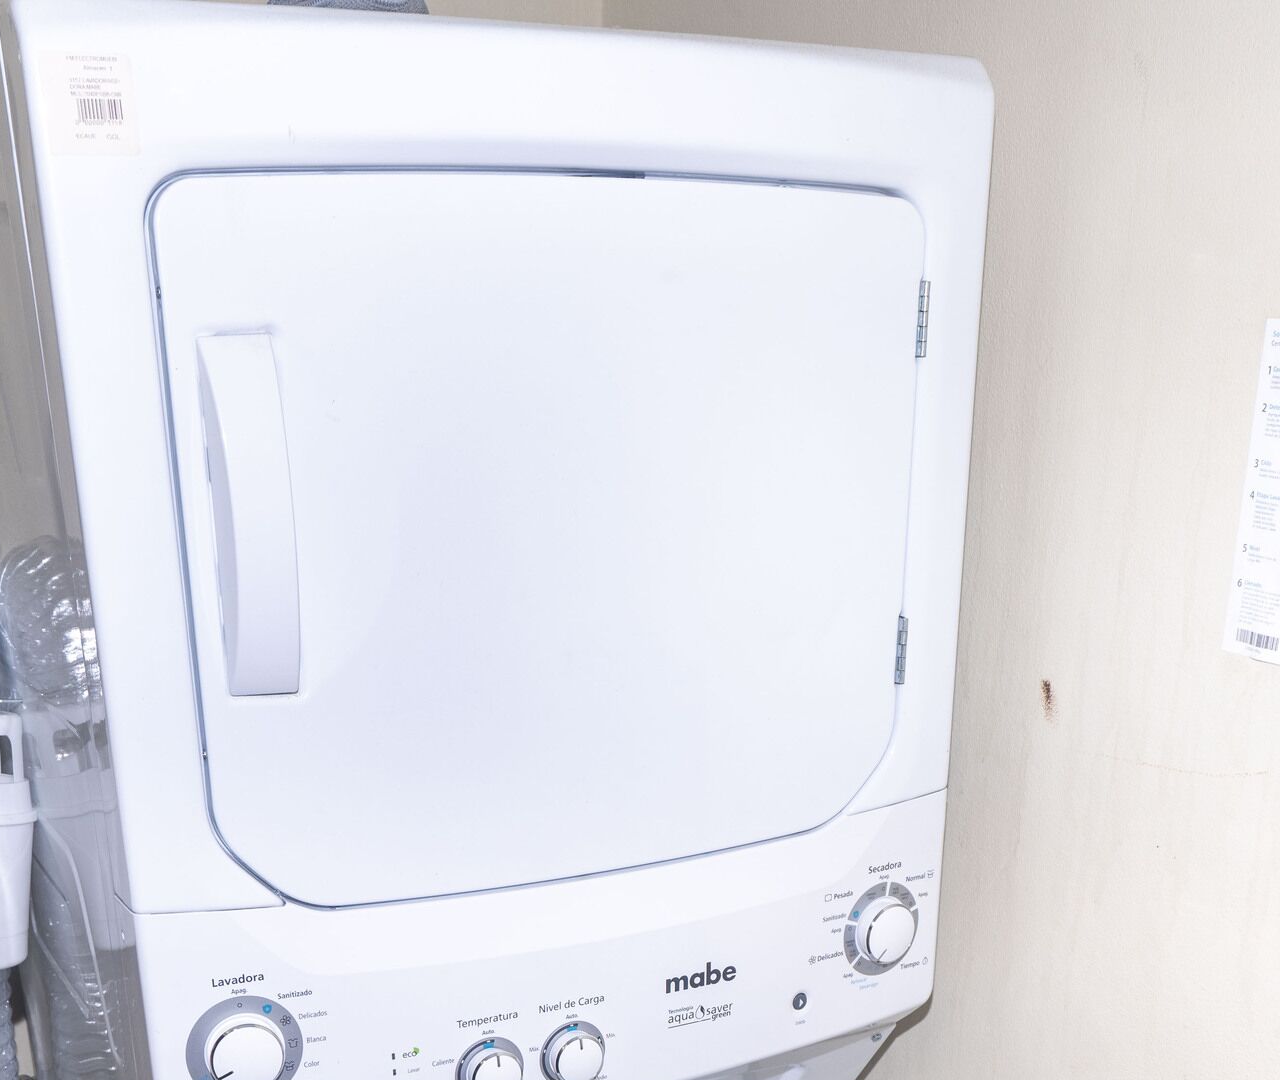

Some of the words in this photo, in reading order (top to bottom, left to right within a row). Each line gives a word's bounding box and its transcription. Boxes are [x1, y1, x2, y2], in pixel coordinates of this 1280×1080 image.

[1268, 366, 1272, 375] 1
[1262, 403, 1267, 413] 2
[1253, 458, 1259, 468] 3
[1250, 490, 1255, 500] 4
[1242, 544, 1248, 552] 5
[1237, 578, 1242, 588] 6
[868, 861, 902, 874] Secadora
[906, 872, 926, 882] Normal
[833, 890, 854, 900] Pesada
[817, 950, 844, 962] Delicados
[900, 960, 920, 970] Tiempo
[212, 973, 265, 988] Lavadora
[665, 962, 737, 994] mabe
[277, 989, 313, 1000] Sanitizado
[538, 1002, 562, 1014] Nivel
[564, 1000, 576, 1008] de
[578, 996, 605, 1006] Carga
[298, 1010, 328, 1020] Delicados
[668, 1012, 694, 1024] aqua
[706, 1002, 734, 1016] saver
[712, 1011, 731, 1022] green
[456, 1010, 518, 1028] Temperatura
[306, 1034, 327, 1044] Blanca
[402, 1050, 418, 1058] eco
[304, 1060, 320, 1068] Color
[432, 1058, 455, 1067] Caliente
